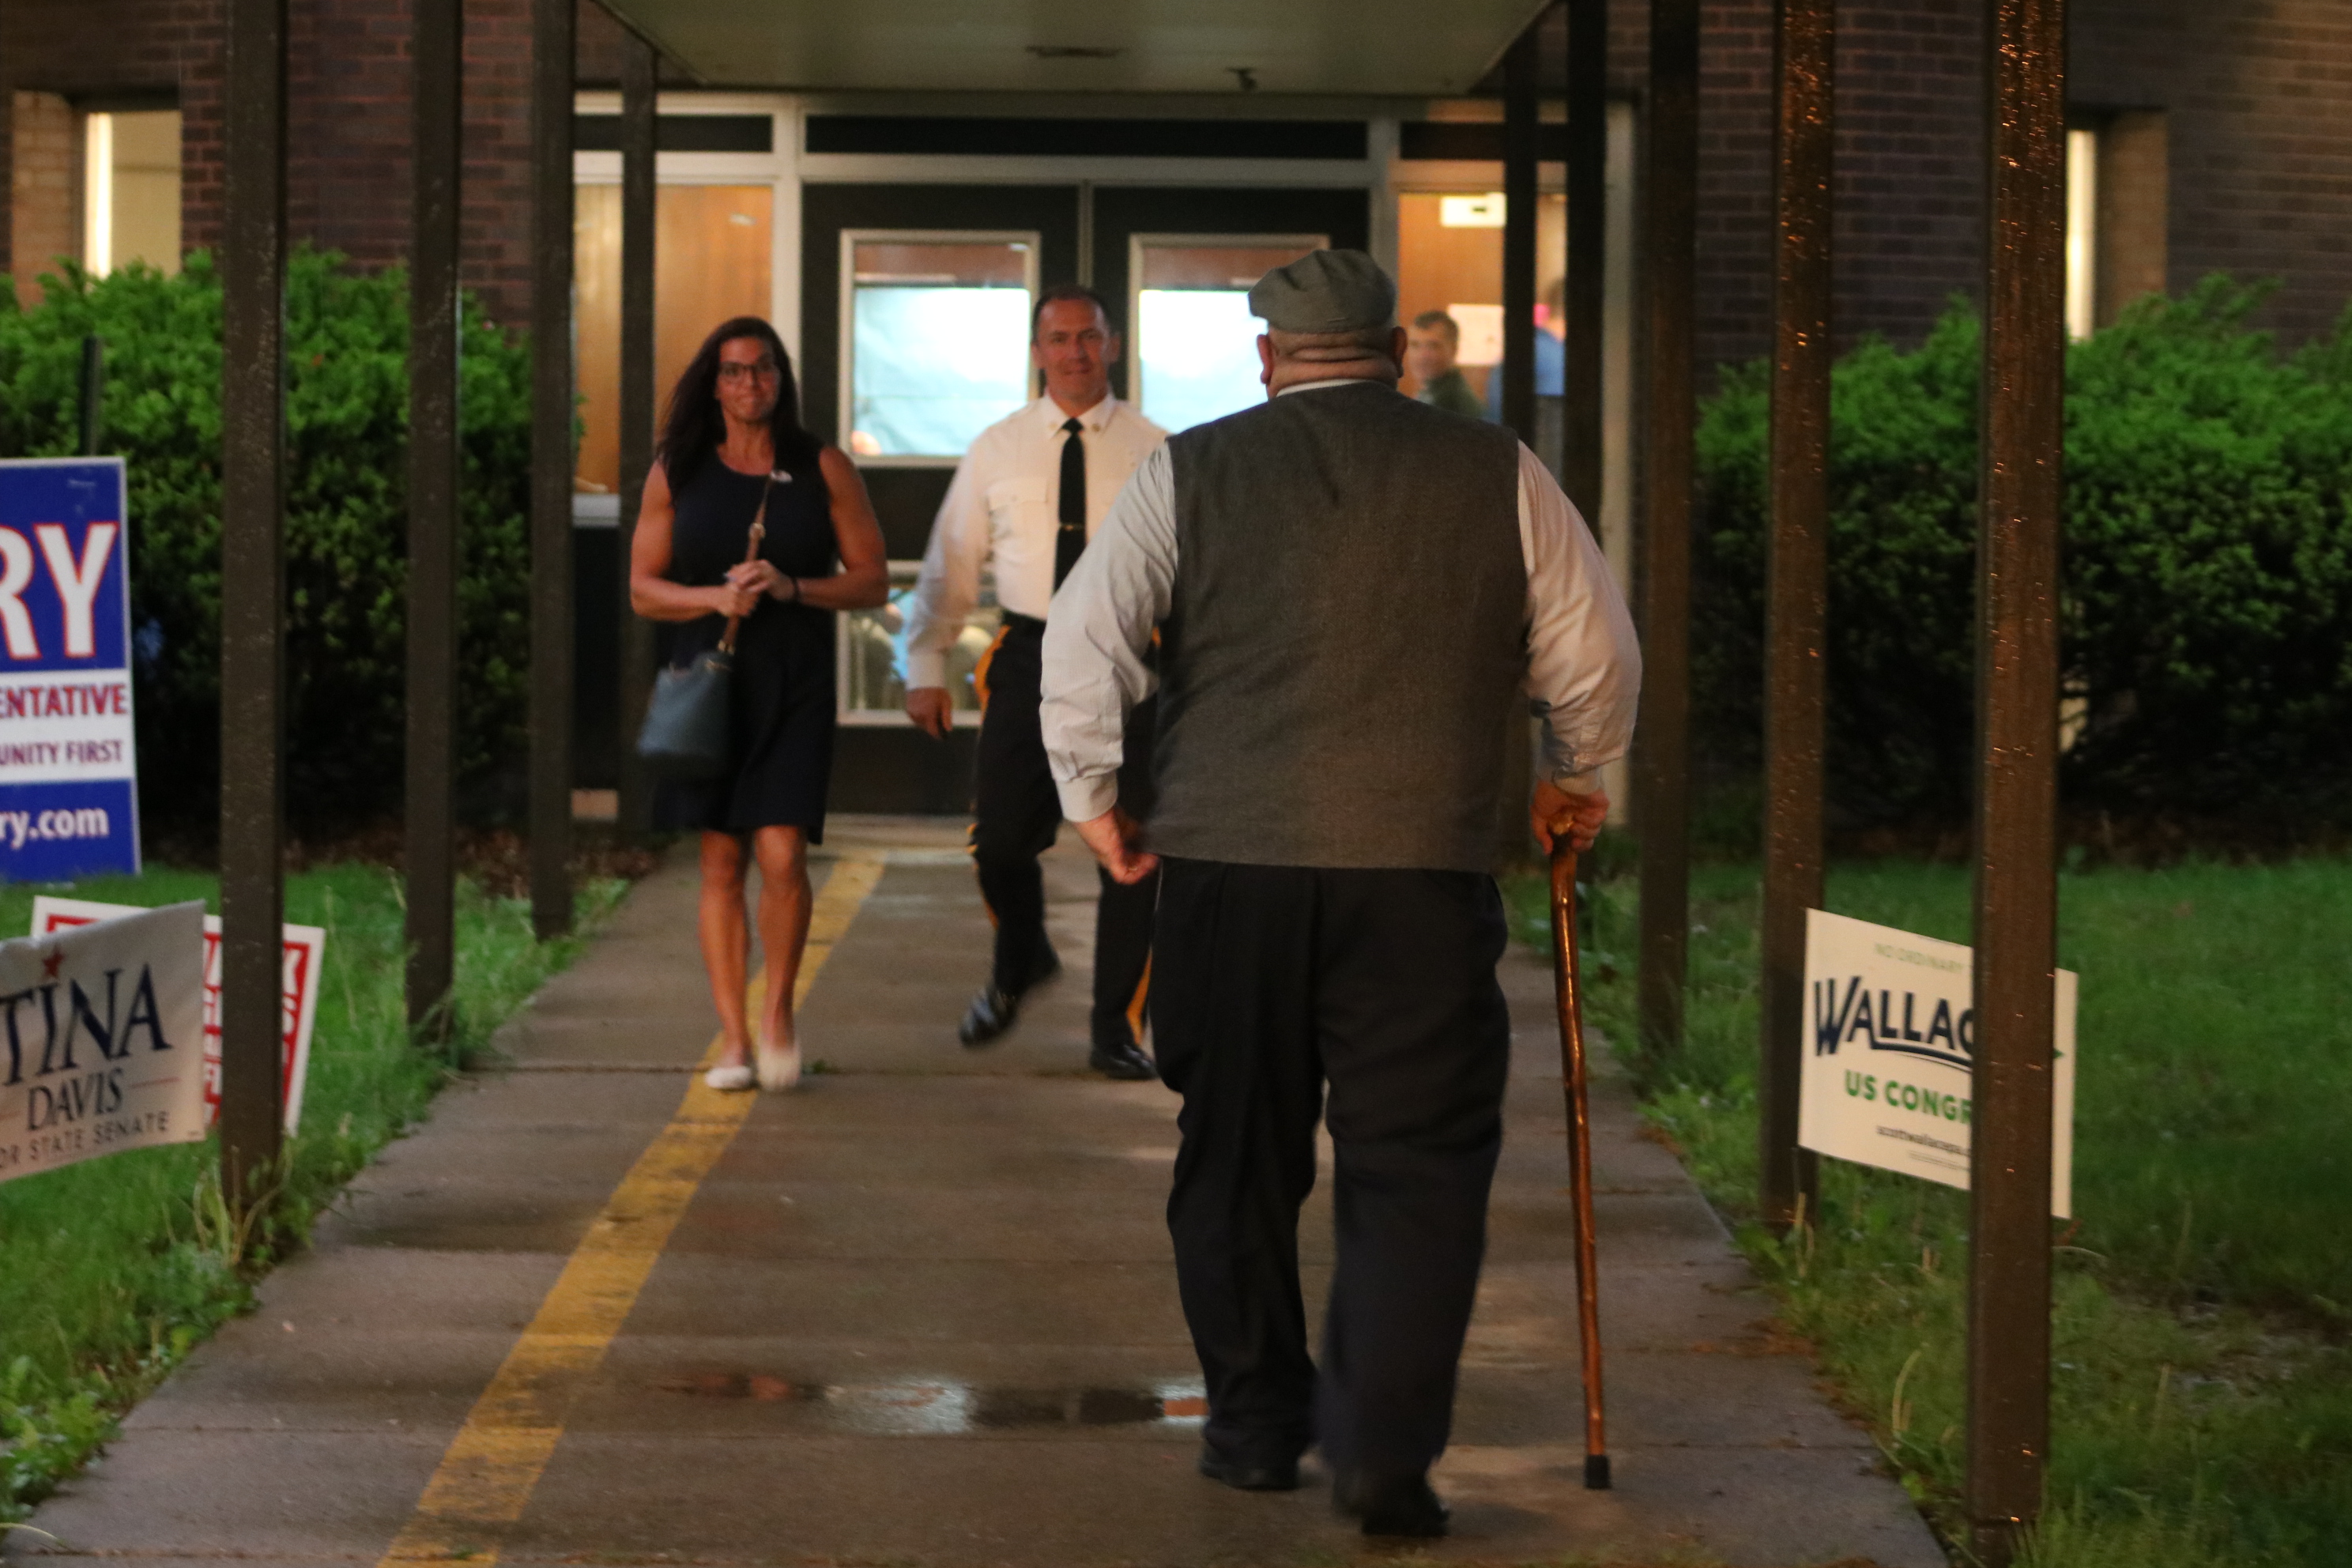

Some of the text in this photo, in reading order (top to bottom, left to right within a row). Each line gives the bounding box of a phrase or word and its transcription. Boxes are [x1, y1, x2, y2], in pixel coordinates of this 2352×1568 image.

[66, 739, 122, 764] FIRST
[27, 1067, 124, 1131] DAVIS
[1845, 1069, 1877, 1101] US
[29, 1128, 84, 1161] STATE
[93, 1110, 168, 1145] SENATE
